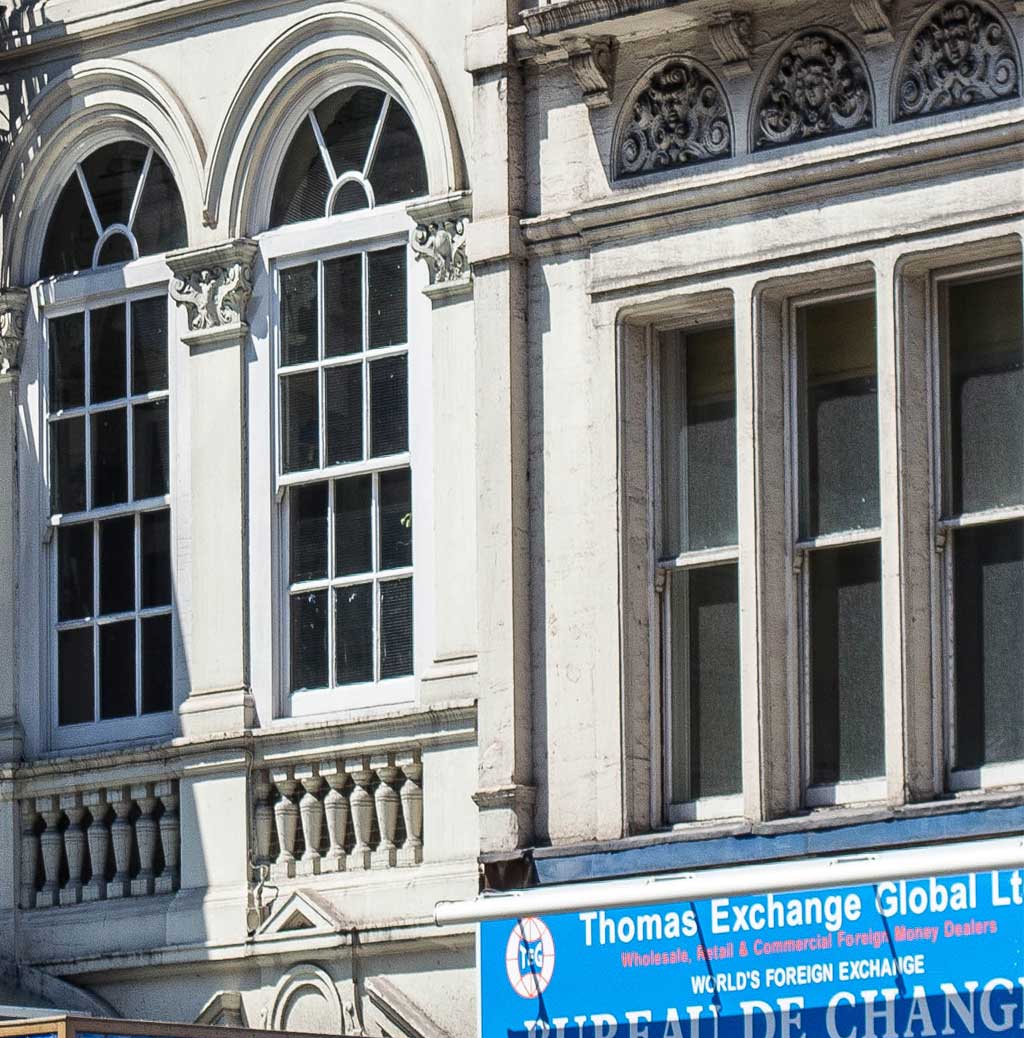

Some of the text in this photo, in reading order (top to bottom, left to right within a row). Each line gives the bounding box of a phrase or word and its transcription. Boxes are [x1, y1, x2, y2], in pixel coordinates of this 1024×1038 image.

[578, 868, 1024, 946] Thomas Exchange Global Lt
[620, 916, 998, 969] Wholesale, Retail & Commercial Foreign Money Dealers
[690, 953, 926, 996] WORLD'S FOREIGN EXCHANGE
